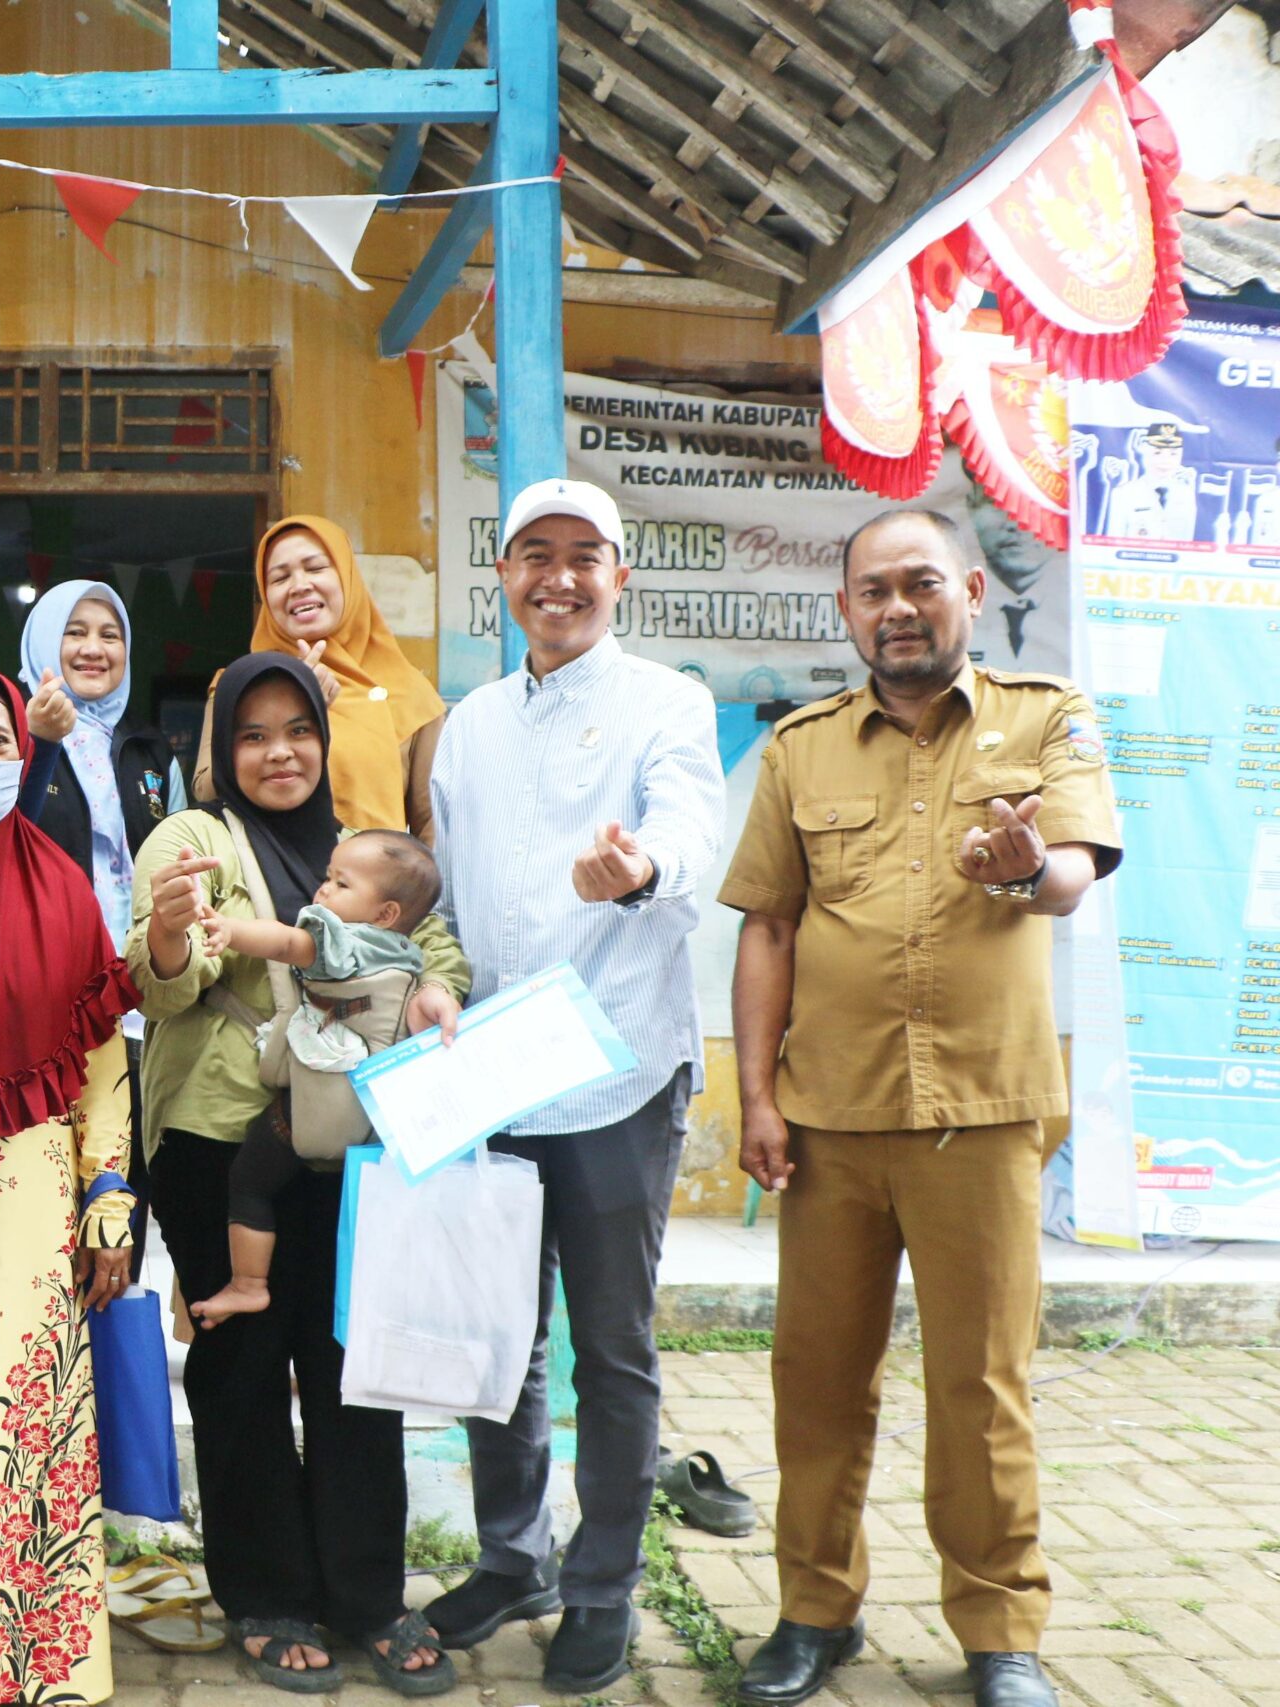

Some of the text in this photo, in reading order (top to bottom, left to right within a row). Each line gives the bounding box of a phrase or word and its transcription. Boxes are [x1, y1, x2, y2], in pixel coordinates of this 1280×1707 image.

[1183, 319, 1227, 331] INTAH
[1217, 357, 1280, 389] GE
[712, 403, 822, 428] KABUPAT
[579, 425, 811, 463] DESA KUBANG
[620, 464, 766, 489] KECAMATAN
[733, 524, 849, 574] Bersat
[1084, 573, 1280, 606] ENIS LAYAN
[640, 588, 856, 643] PERUBAHA
[1113, 607, 1182, 623] Keluarga
[1095, 698, 1127, 709] -1.06
[1239, 759, 1263, 771] KTP
[1236, 777, 1269, 792] Data,
[1240, 991, 1264, 1003] KTP
[1238, 1007, 1270, 1020] Surat
